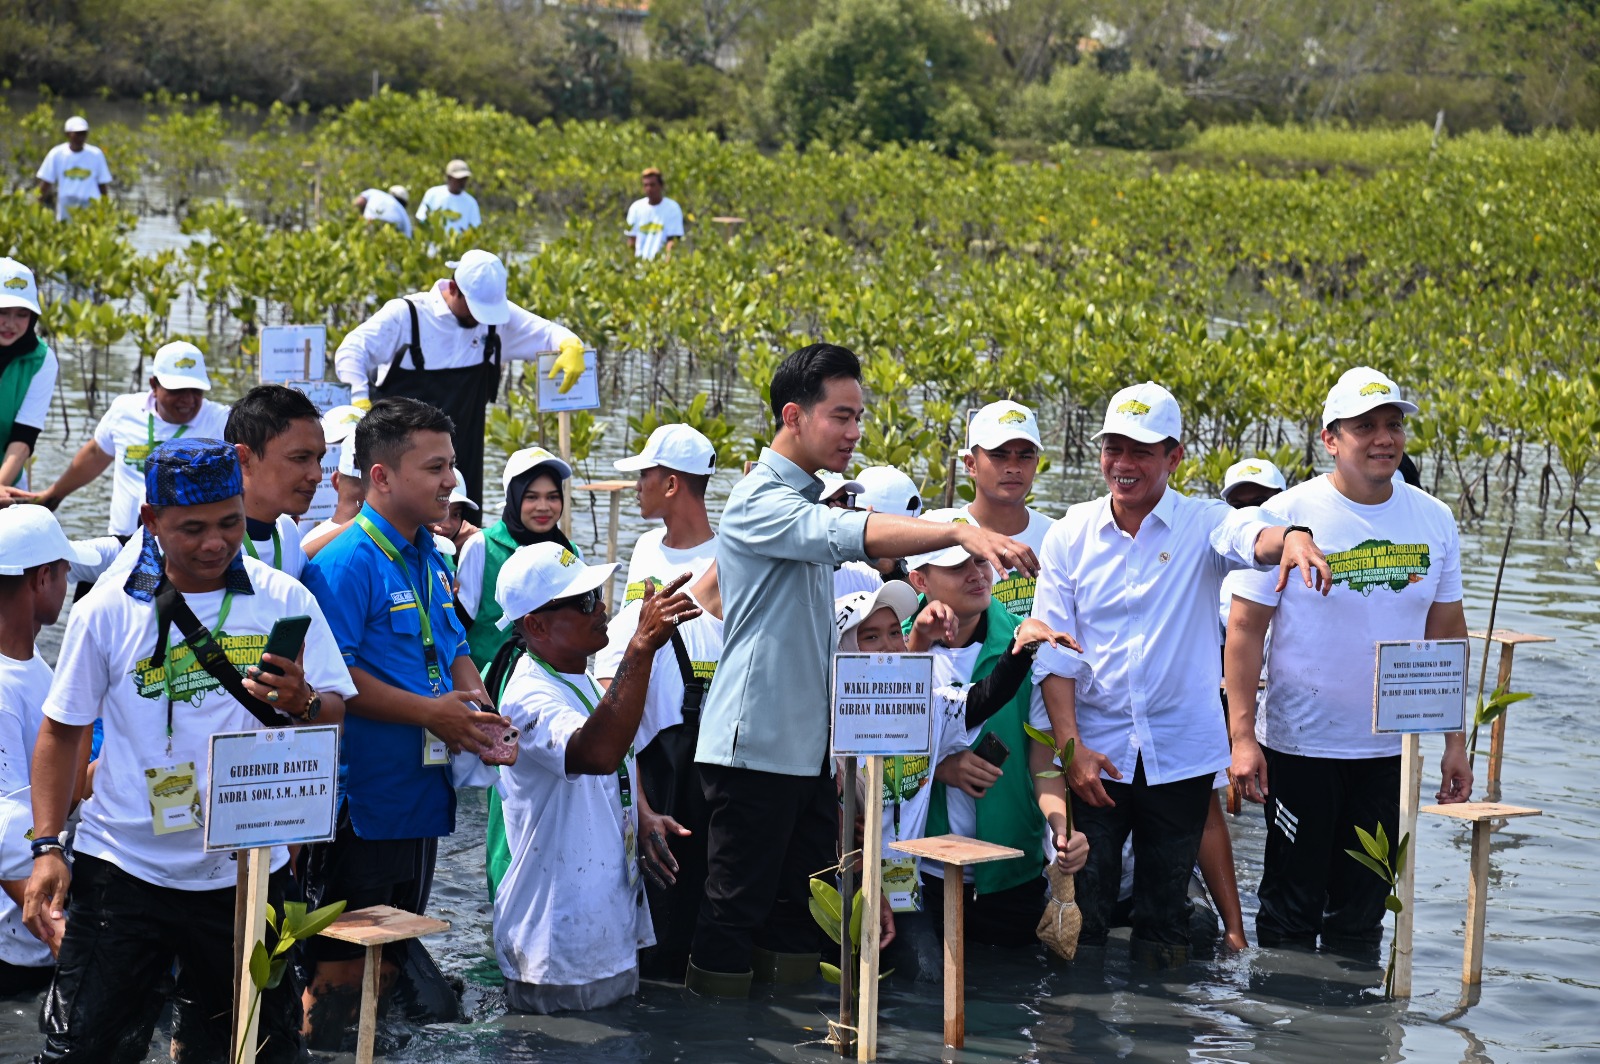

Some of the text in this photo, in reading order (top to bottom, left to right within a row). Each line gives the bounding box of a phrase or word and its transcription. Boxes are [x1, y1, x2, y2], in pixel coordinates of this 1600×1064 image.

[1372, 546, 1387, 556] DAN
[1387, 544, 1429, 555] PENGELOLAAN
[1330, 554, 1422, 573] EKOSISTEM MANGROVE
[844, 682, 925, 695] WAKIL PRESIDEN RI
[839, 703, 926, 716] GIBRAN RAKABUMING
[230, 759, 319, 778] GUBERNUR BANTEN
[218, 789, 248, 804] ANDRA
[251, 788, 274, 801] SONI,
